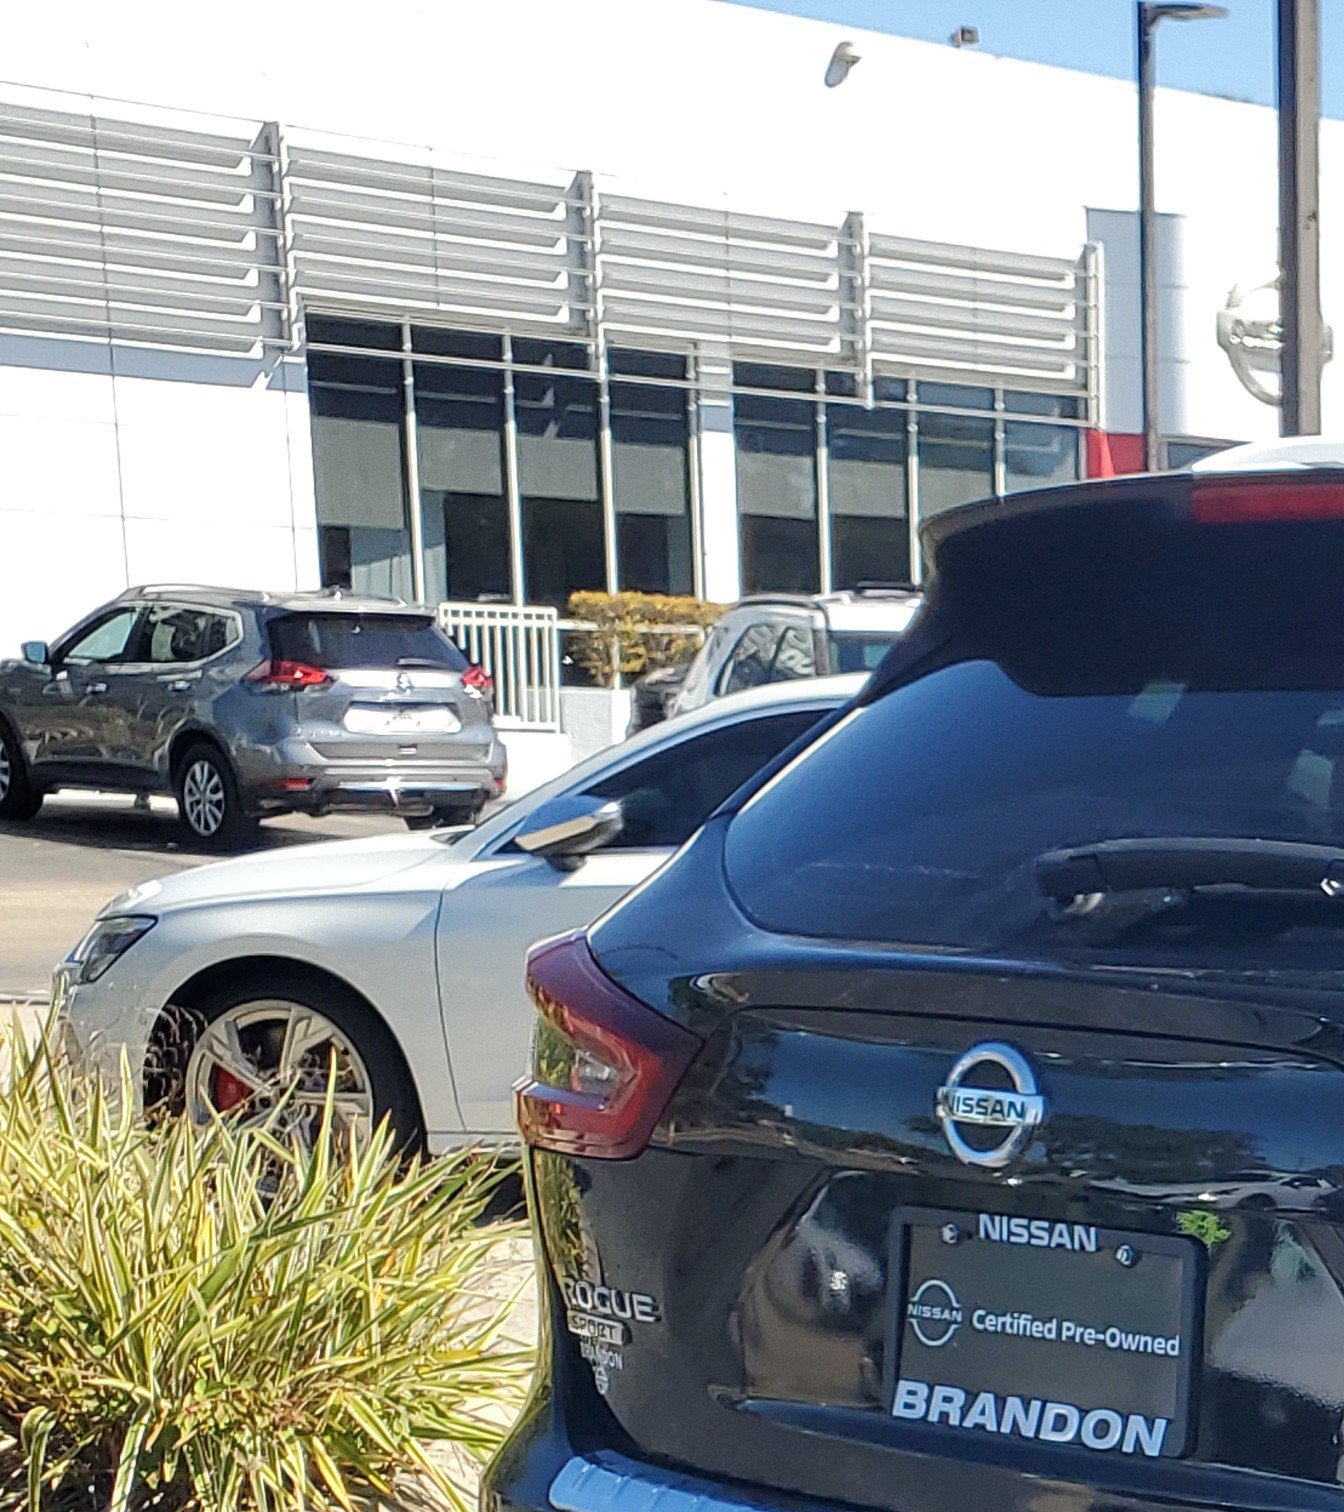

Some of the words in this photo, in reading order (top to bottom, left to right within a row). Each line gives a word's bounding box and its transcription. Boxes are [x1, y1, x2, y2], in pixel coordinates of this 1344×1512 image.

[945, 1094, 1025, 1119] NISSAN
[979, 1214, 1098, 1252] NISSAN
[562, 1278, 659, 1322] ROGUE
[907, 1304, 962, 1322] NISSAN
[570, 1315, 616, 1340] SPORT
[971, 1309, 1057, 1341] Certified
[1061, 1321, 1180, 1356] Pre-Owned
[891, 1379, 1168, 1457] BRANDON
